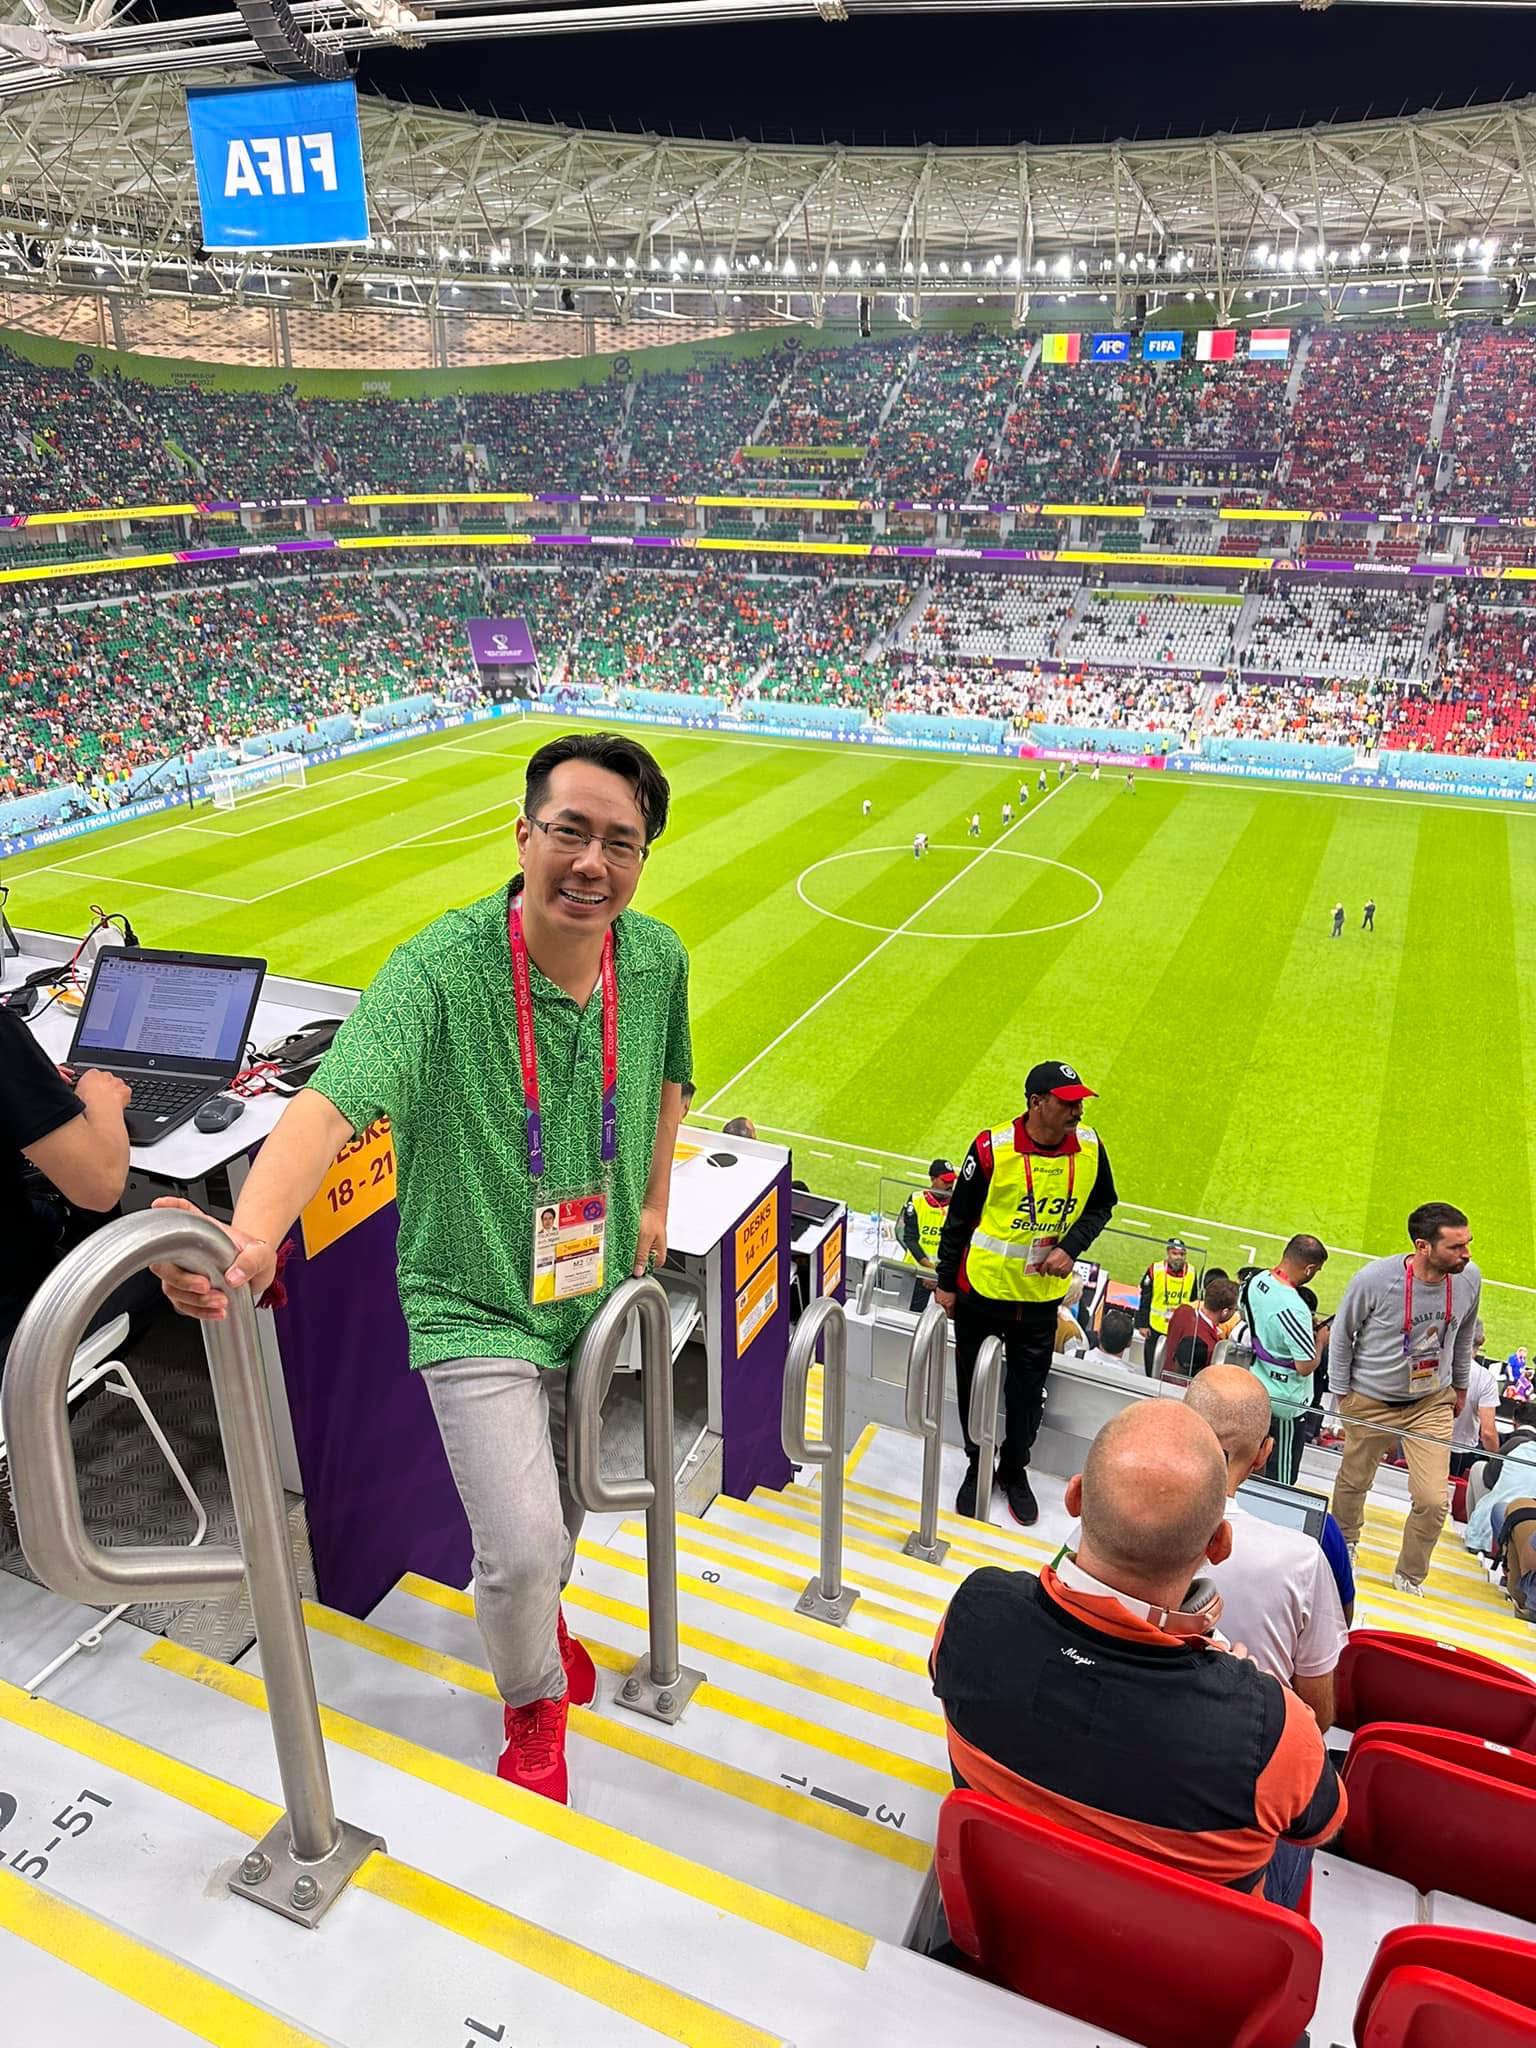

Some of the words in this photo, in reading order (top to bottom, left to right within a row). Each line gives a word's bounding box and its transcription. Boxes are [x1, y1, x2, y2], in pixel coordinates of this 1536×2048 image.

[1096, 340, 1124, 354] AFC
[1149, 340, 1176, 352] FIFA
[872, 735, 917, 747] HIGHLIGHTS
[918, 738, 940, 749] FROM
[942, 740, 966, 751] EVERY
[967, 742, 998, 754] MATCH
[1190, 761, 1244, 774] HIGHLIGHTS
[1246, 765, 1274, 777] FROM
[1275, 768, 1304, 779] EVERY
[1305, 770, 1342, 783] MATCH
[1396, 778, 1455, 793] HIGHLIGHTS
[1457, 783, 1487, 797] FROM
[1488, 786, 1521, 800] EVERY
[33, 823, 86, 846] HIGHLIGHTS
[86, 814, 110, 830] FROM
[111, 807, 137, 823] EVERY
[136, 799, 166, 815] MATCH
[522, 1009, 530, 1024] CUP
[523, 1024, 532, 1052] WORLD
[525, 1053, 533, 1069] FIFA
[329, 1117, 392, 1169] ESKS
[327, 1178, 354, 1213] 18
[370, 1150, 393, 1186] 21
[743, 1203, 771, 1245] DESKS
[1010, 1218, 1071, 1234] Securiy
[745, 1244, 755, 1264] 14
[761, 1227, 769, 1248] 17
